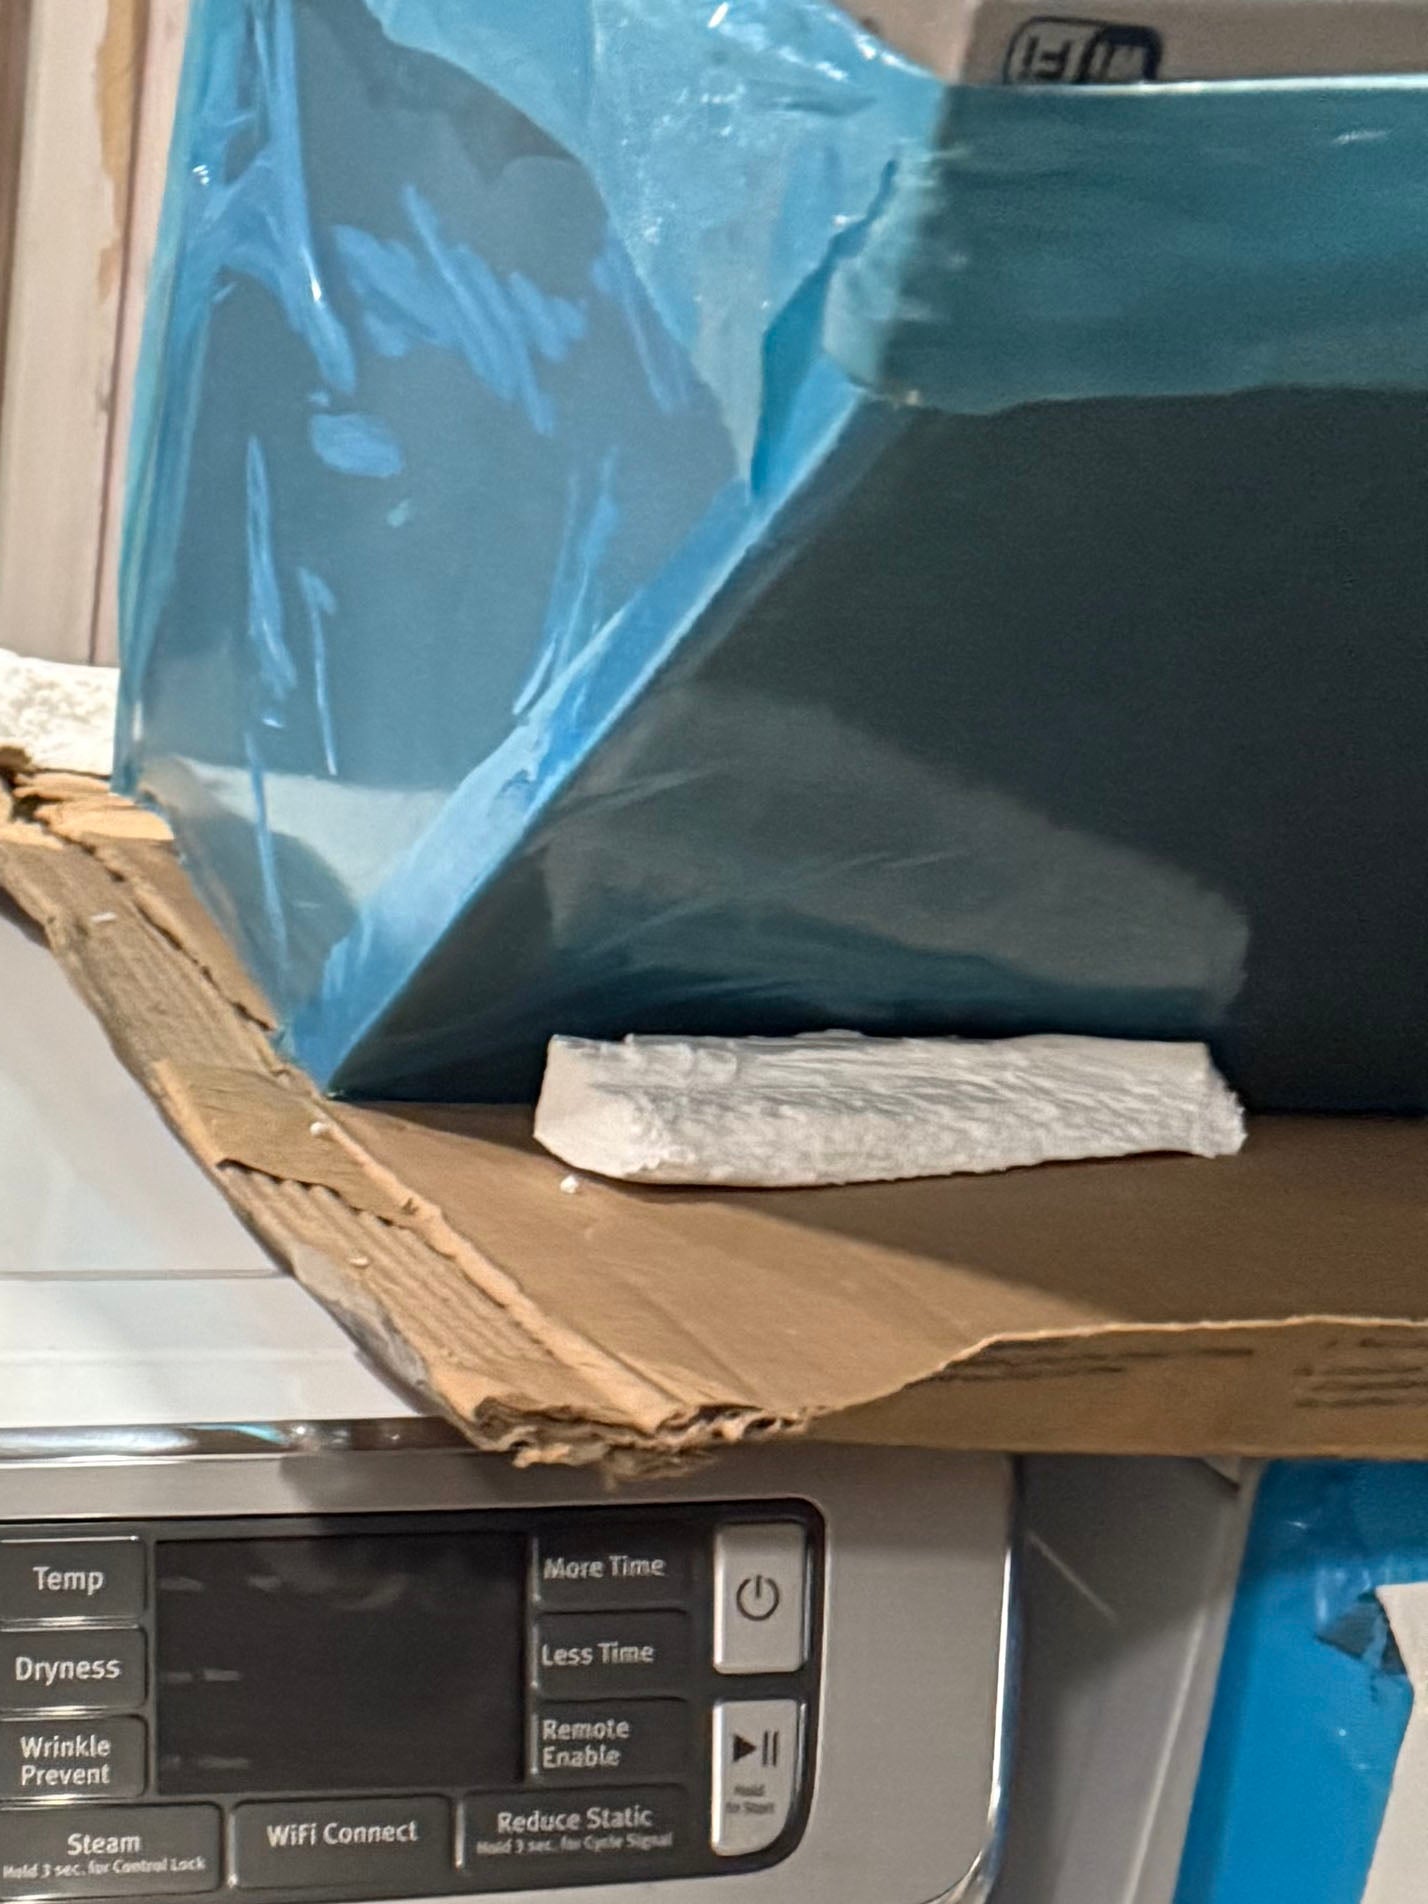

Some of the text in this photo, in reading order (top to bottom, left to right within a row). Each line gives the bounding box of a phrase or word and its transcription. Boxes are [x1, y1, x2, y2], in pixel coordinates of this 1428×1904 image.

[544, 1555, 666, 1580] More Time
[32, 1566, 104, 1595] Temp
[541, 1642, 656, 1667] Less Time
[15, 1656, 122, 1686] Dryness
[543, 1719, 631, 1740] Remote
[20, 1734, 112, 1759] Wrinkle
[543, 1745, 622, 1768] Enable
[21, 1764, 111, 1787] Prevent
[497, 1804, 654, 1833] Reduce Static
[67, 1833, 142, 1856] Steam
[266, 1820, 419, 1848] WiFi Connect
[476, 1838, 513, 1854] Hold
[515, 1839, 524, 1853] 3
[559, 1836, 582, 1850] for
[583, 1834, 624, 1852] Cycle
[626, 1832, 673, 1850] Signal
[2, 1855, 207, 1879] Hold 3 sec. for Control Lock
